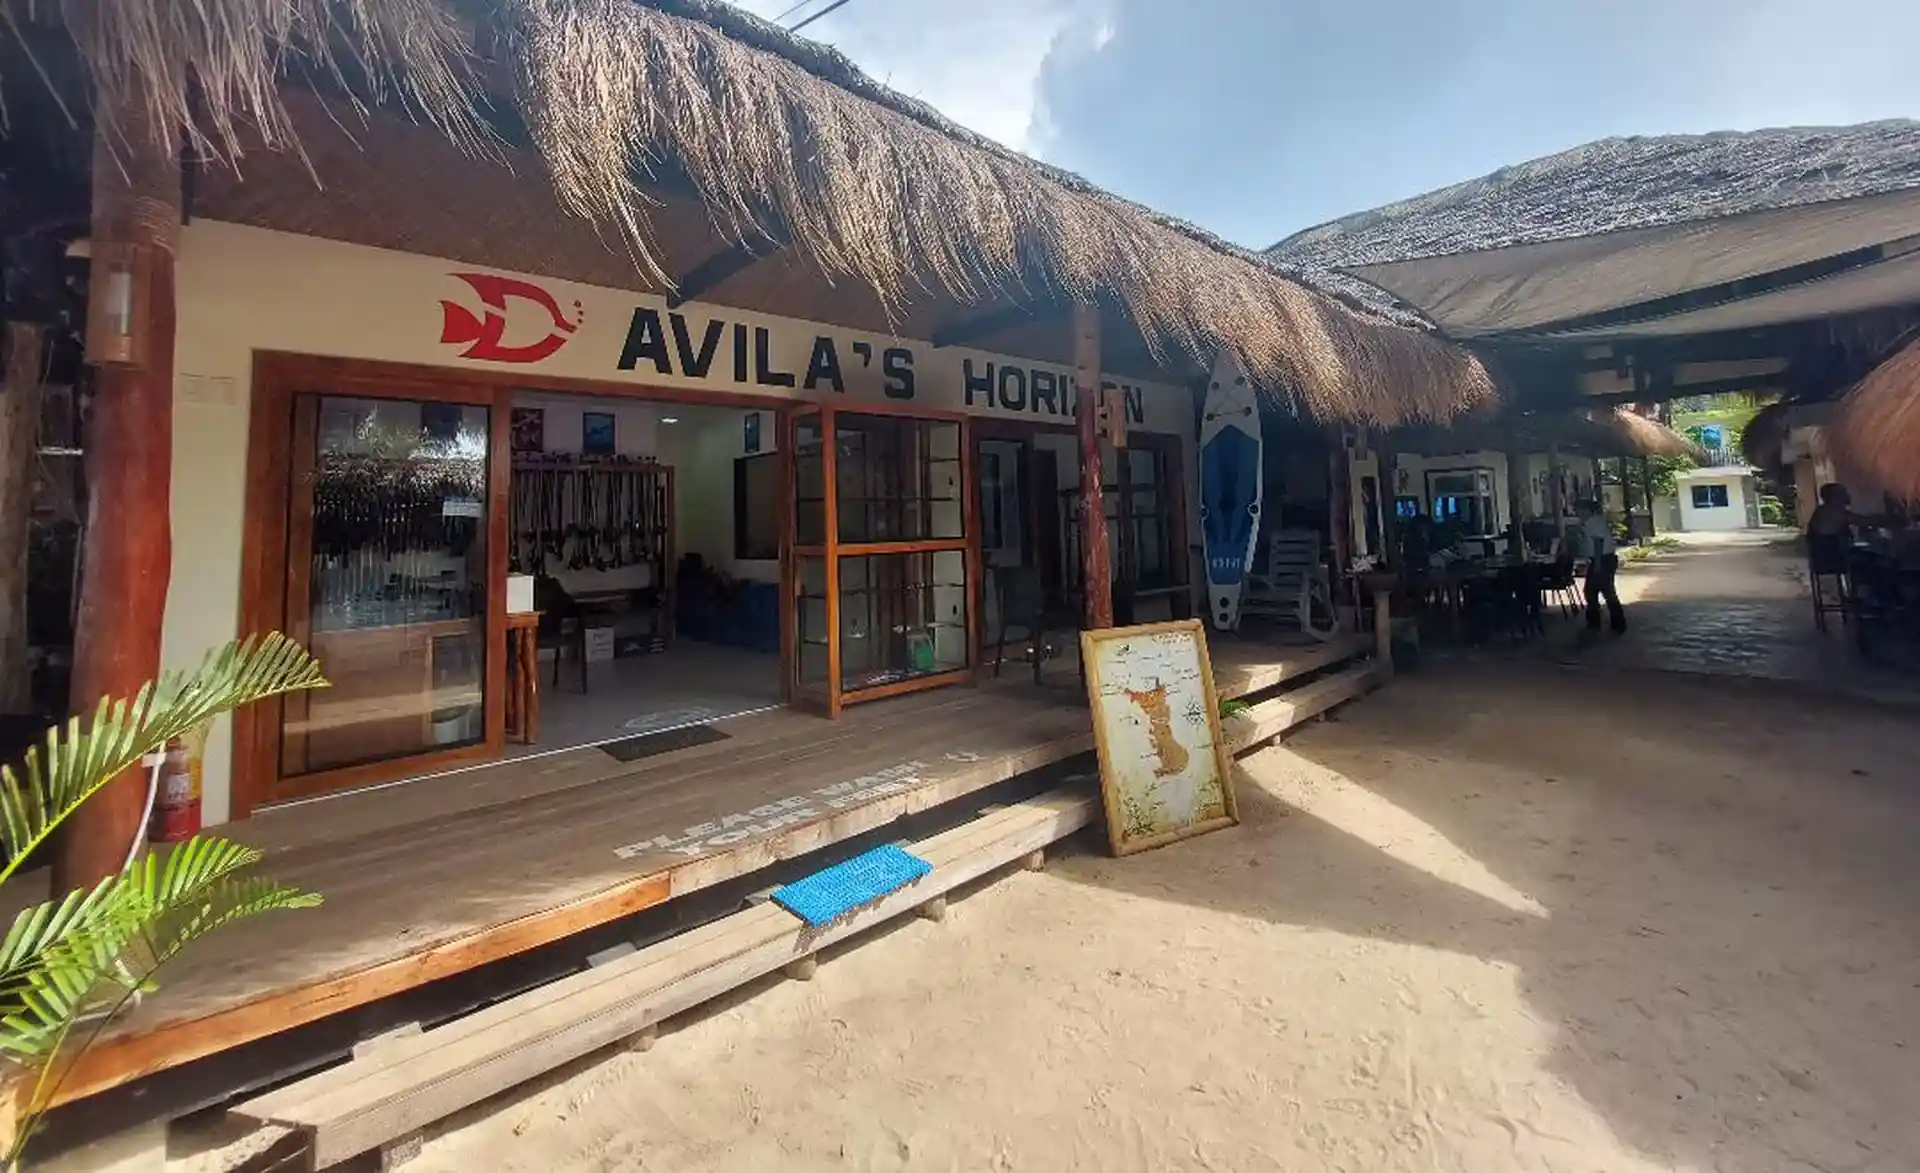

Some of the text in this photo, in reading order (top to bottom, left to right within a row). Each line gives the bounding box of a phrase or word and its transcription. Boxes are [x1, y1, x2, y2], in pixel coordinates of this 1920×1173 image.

[617, 307, 915, 400] AVILA'S
[963, 358, 1144, 424] HORIN
[612, 795, 813, 858] PLEASE
[667, 808, 822, 856] YOUR
